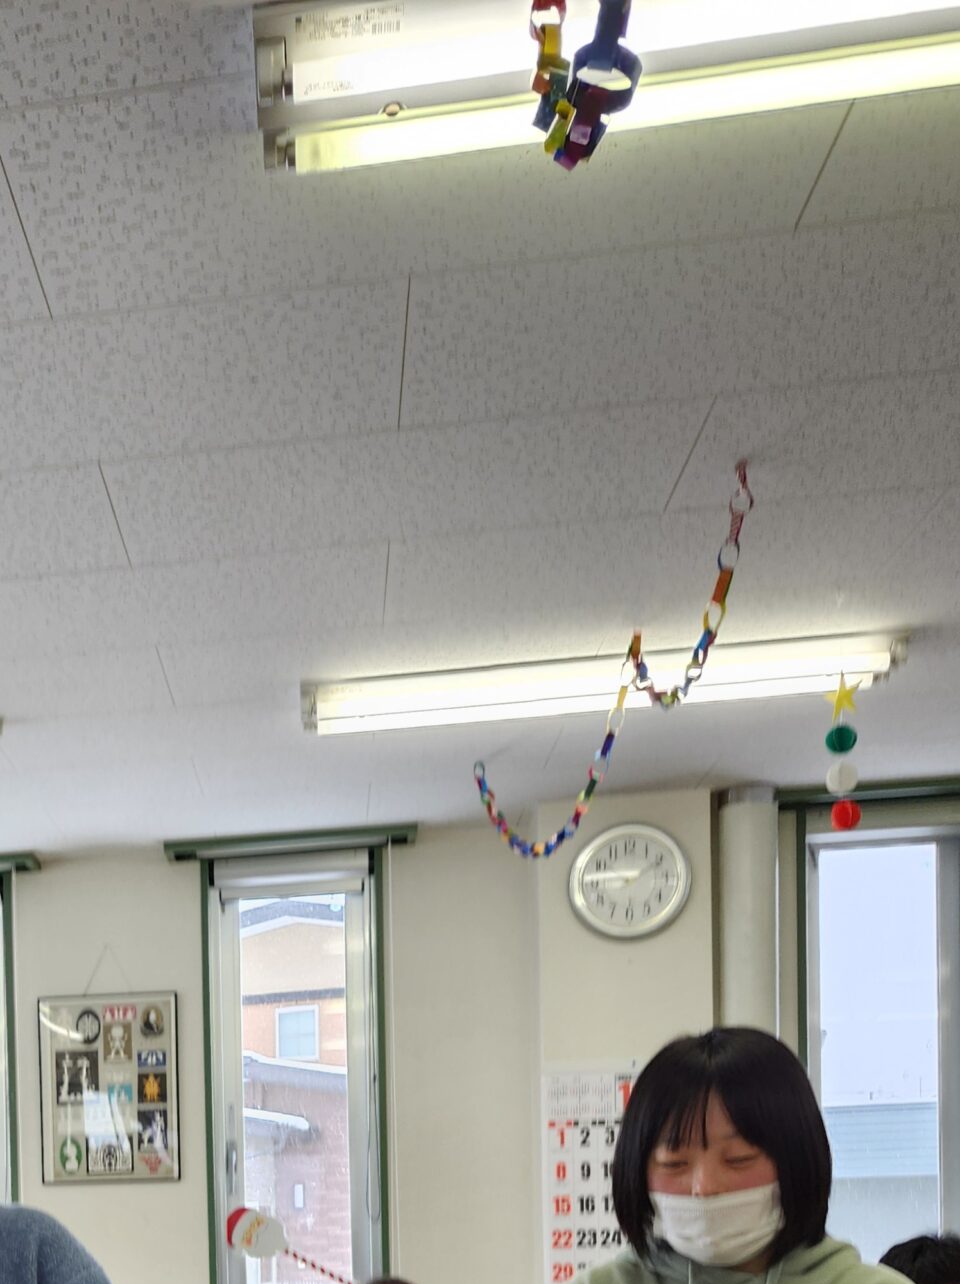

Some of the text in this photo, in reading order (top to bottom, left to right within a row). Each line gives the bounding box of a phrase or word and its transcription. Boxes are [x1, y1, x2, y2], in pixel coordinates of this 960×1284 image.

[609, 844, 618, 861] 11
[624, 838, 637, 857] 12
[557, 1126, 616, 1149] 1 2 3
[580, 1160, 592, 1181] 9
[553, 1195, 572, 1217] 15
[578, 1194, 596, 1215] 16
[552, 1228, 622, 1250] 22 23 24
[552, 1262, 575, 1284] 29
